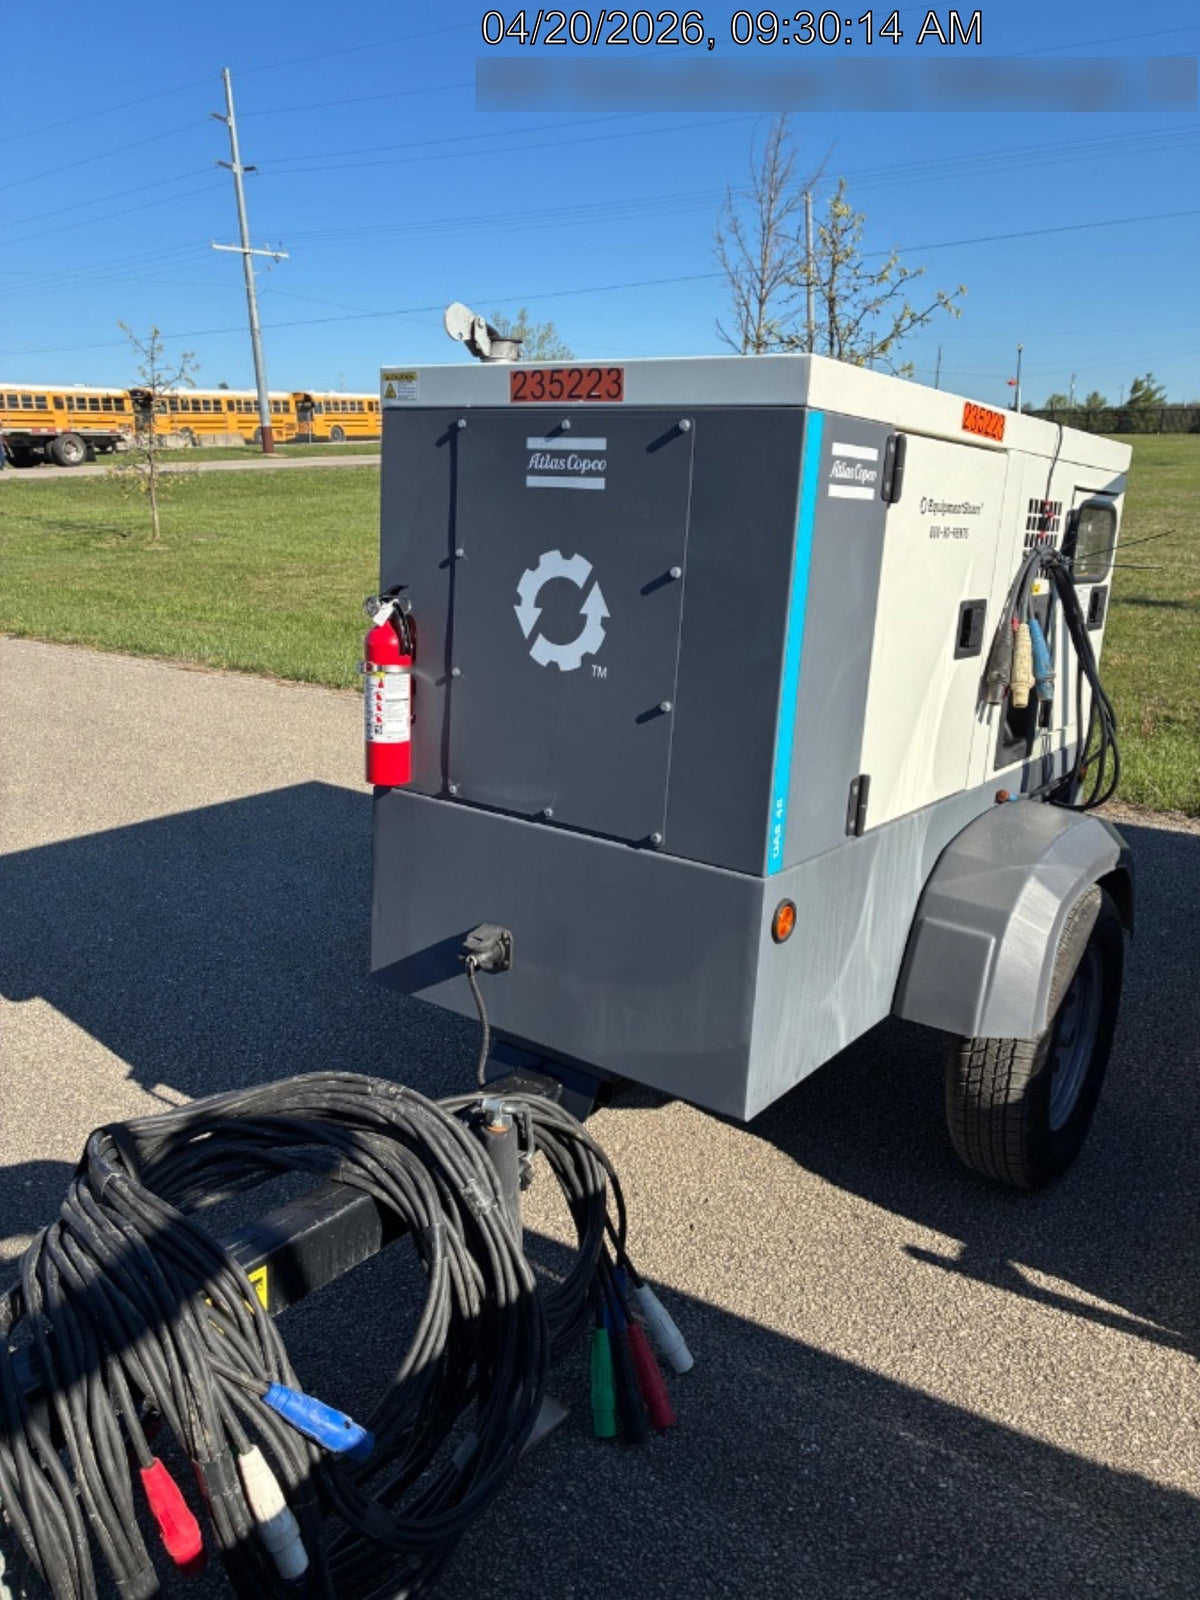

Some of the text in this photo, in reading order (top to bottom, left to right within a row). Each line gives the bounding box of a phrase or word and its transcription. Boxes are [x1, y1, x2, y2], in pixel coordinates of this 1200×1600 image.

[512, 367, 622, 400] 235223
[962, 401, 1005, 441] 235223
[527, 452, 607, 474] Atlas Copco
[829, 460, 878, 484] Atlas Copco
